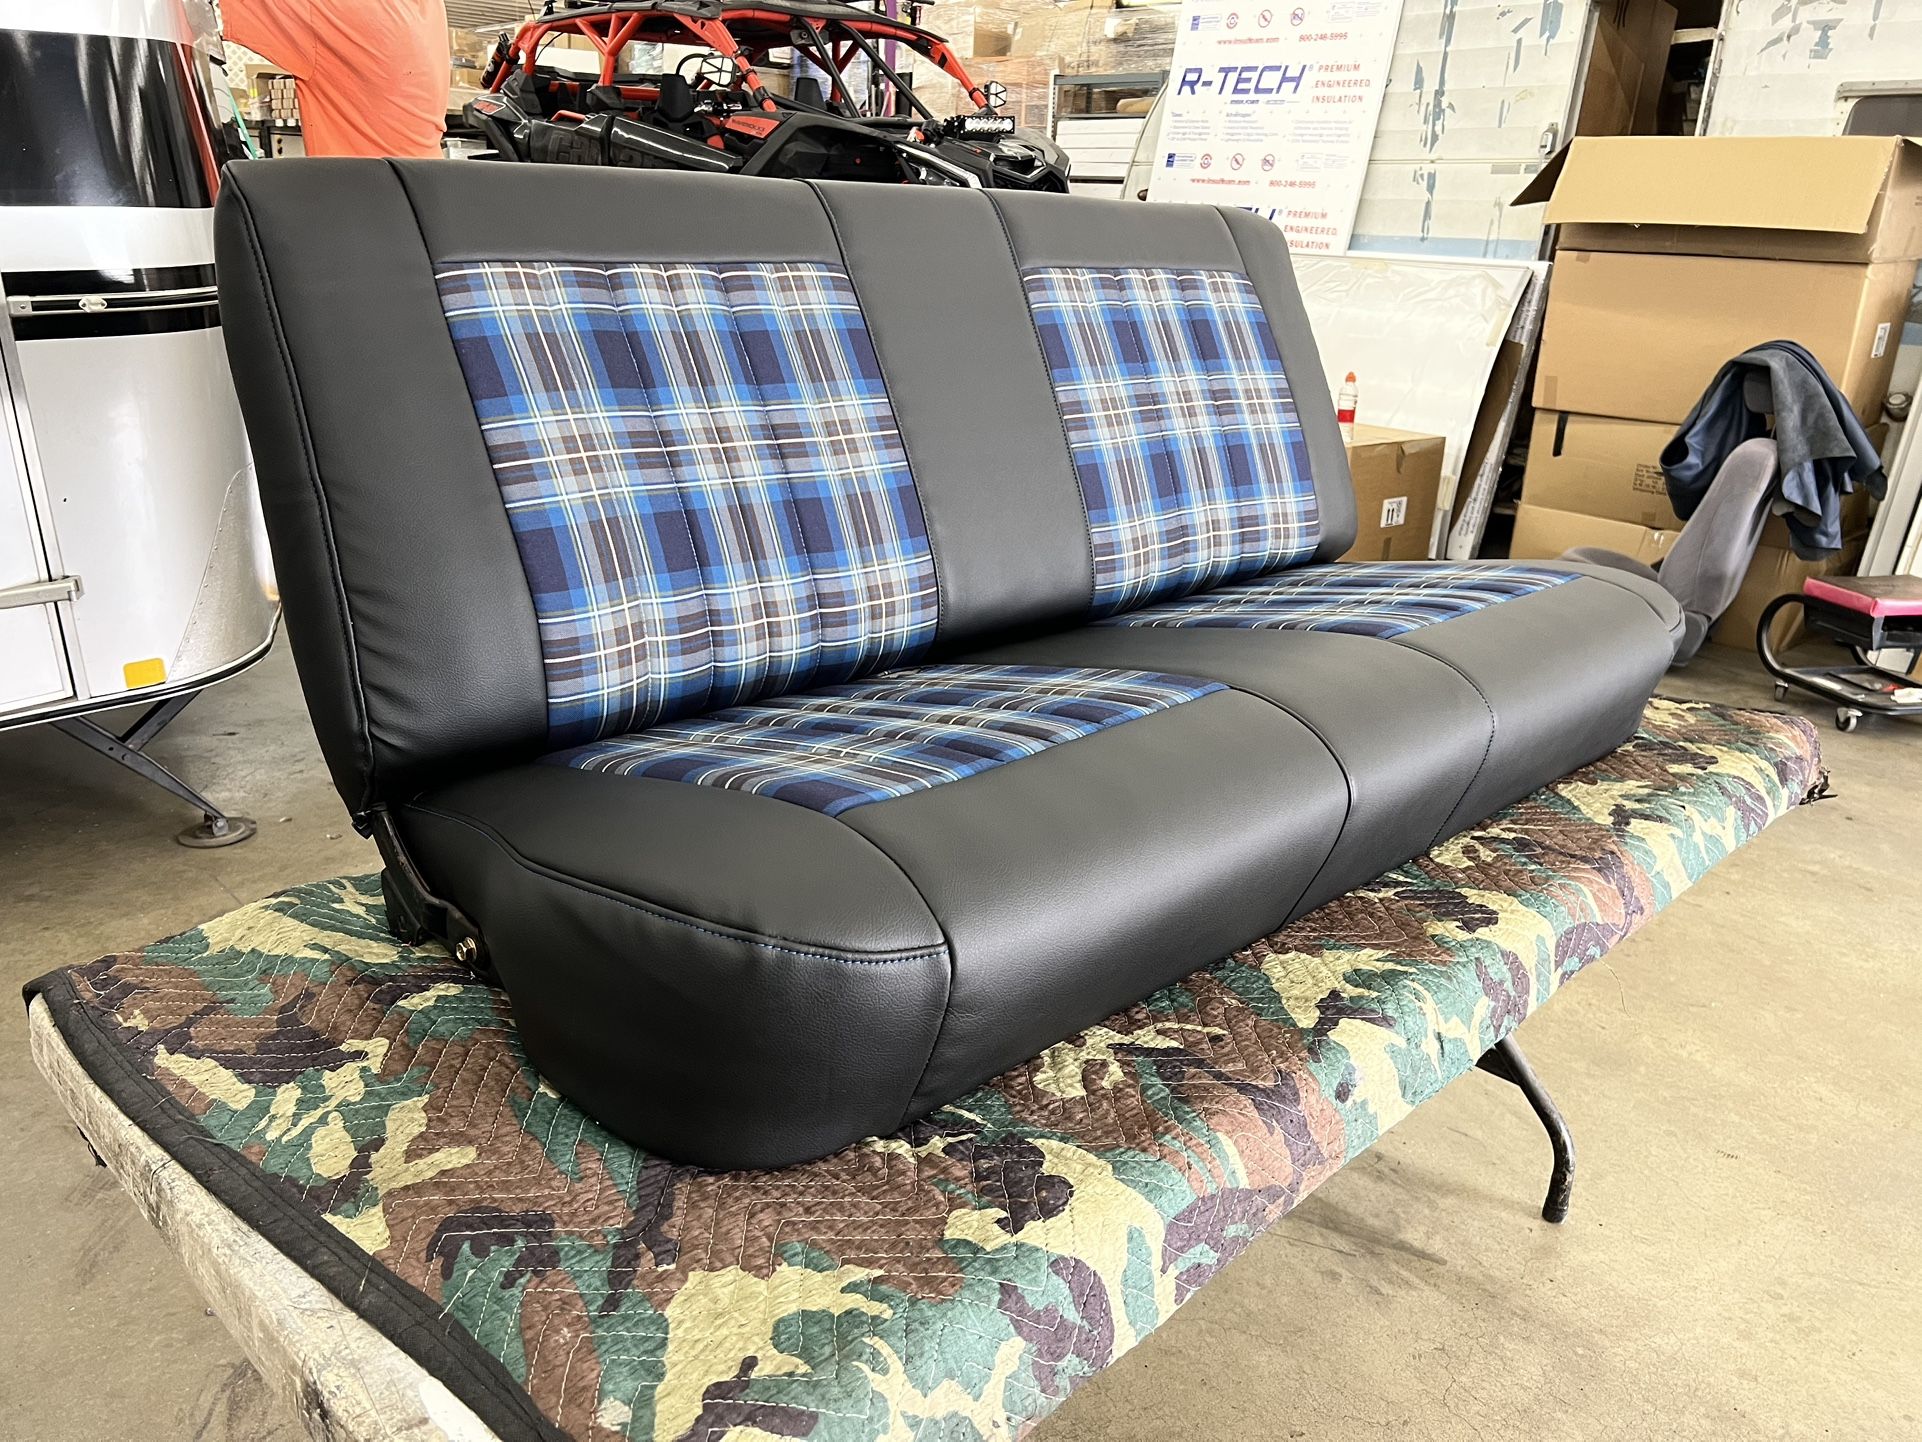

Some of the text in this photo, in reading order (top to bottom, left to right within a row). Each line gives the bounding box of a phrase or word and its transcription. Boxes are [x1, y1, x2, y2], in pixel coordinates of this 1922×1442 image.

[1318, 63, 1361, 73] PREMIUM
[1177, 64, 1307, 95] R-TECH
[1314, 79, 1370, 89] ENGINEERED
[1311, 95, 1364, 104] INSULATION
[1286, 210, 1328, 220] PREMIUM
[1284, 224, 1338, 236] ENGINEERED
[1287, 239, 1331, 250] SULATION
